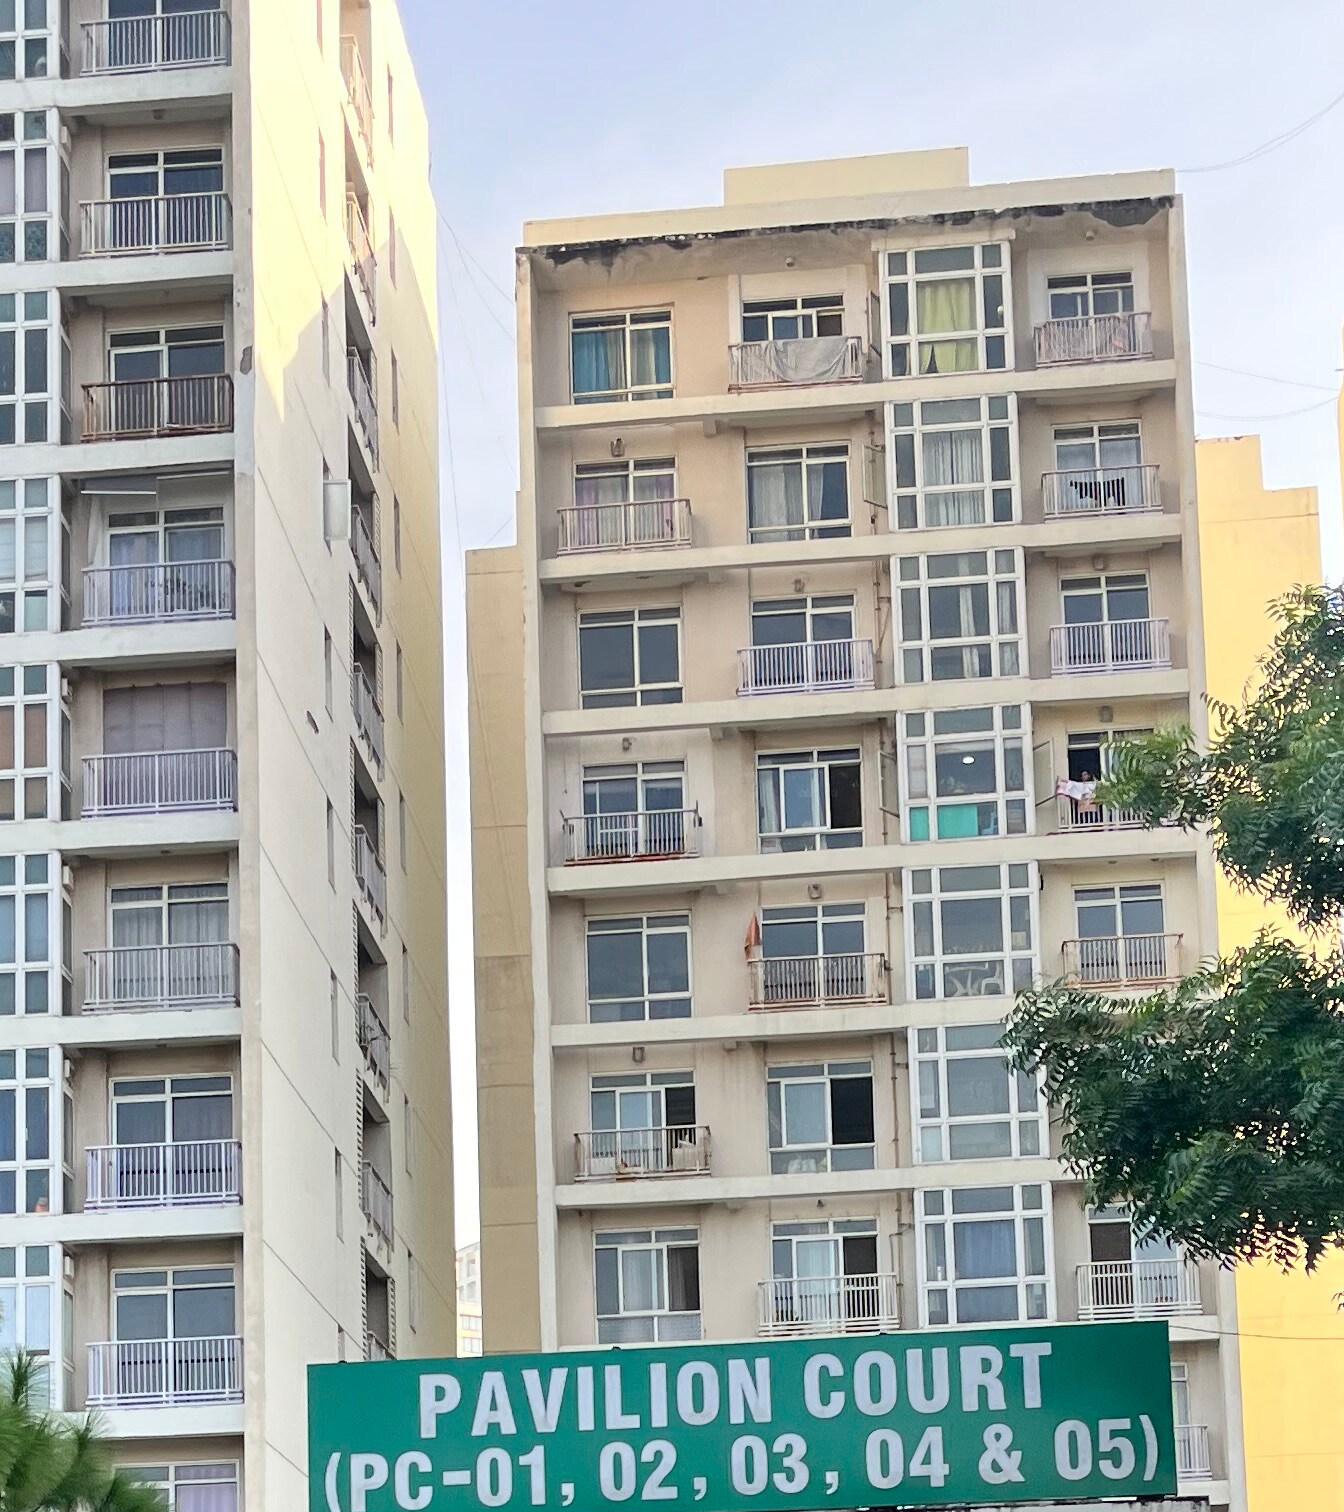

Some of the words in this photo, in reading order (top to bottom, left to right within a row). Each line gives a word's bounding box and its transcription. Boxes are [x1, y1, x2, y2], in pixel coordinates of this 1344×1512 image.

[419, 1357, 773, 1439] PAVILION
[803, 1342, 1053, 1419] COURT
[599, 1439, 708, 1502] 02,
[731, 1433, 840, 1496] 03,
[865, 1426, 950, 1489] 04
[978, 1423, 1025, 1484] &
[1054, 1414, 1159, 1481] 05)
